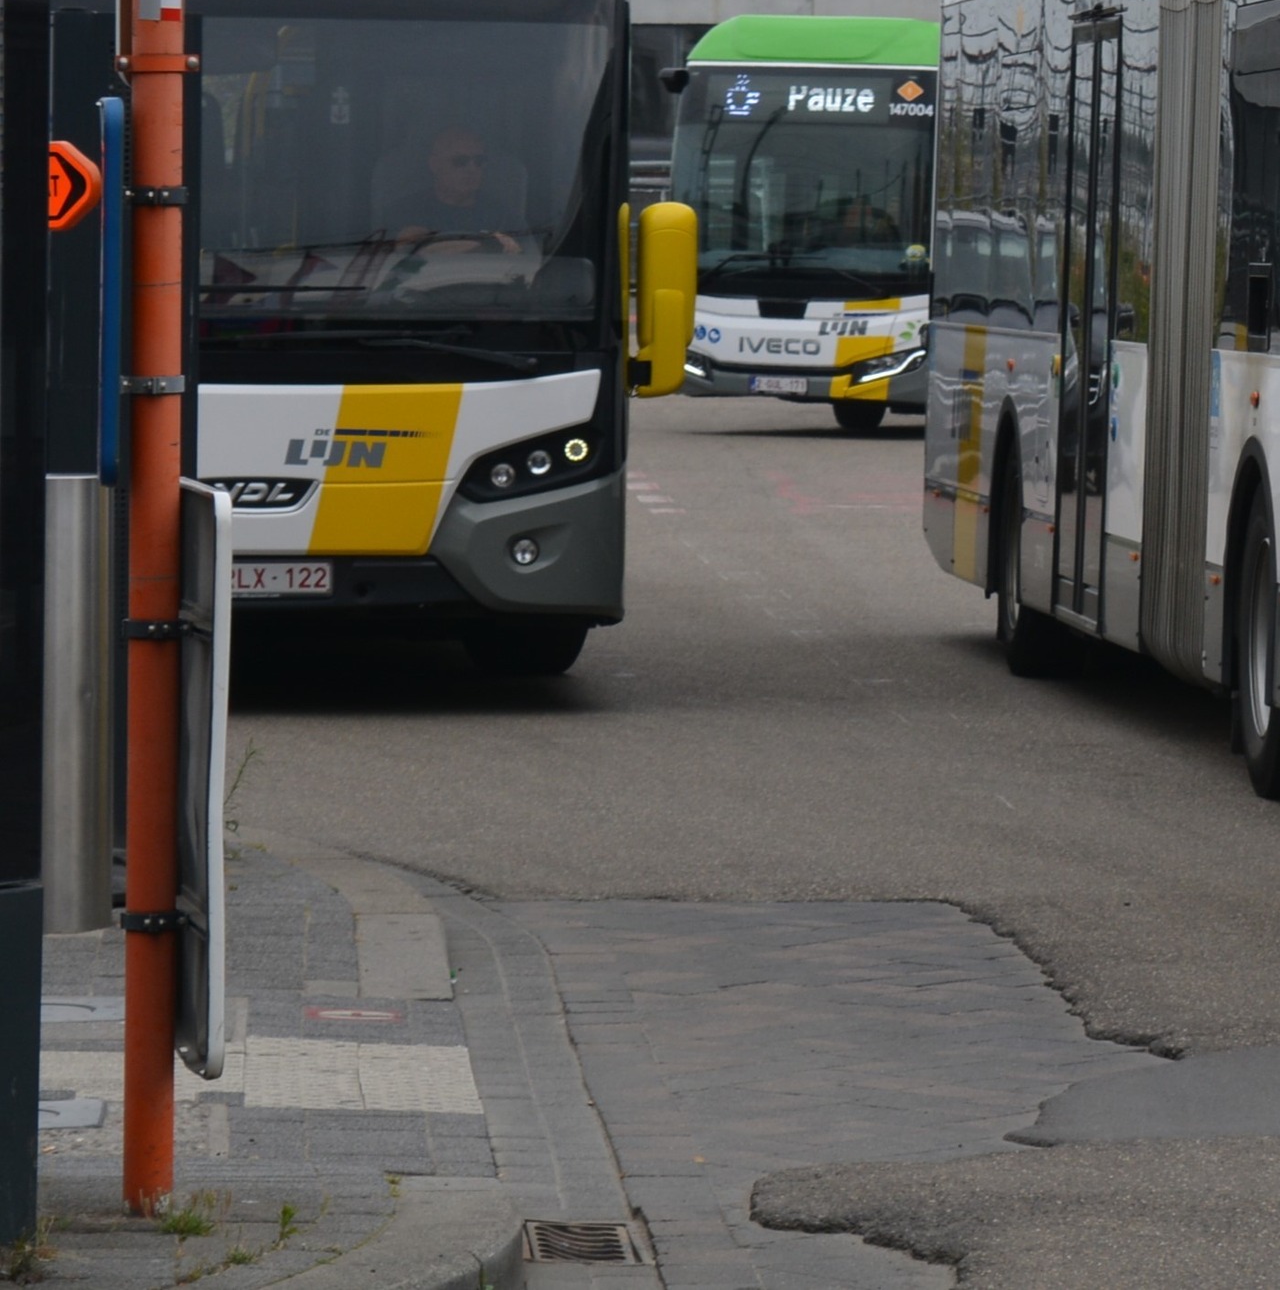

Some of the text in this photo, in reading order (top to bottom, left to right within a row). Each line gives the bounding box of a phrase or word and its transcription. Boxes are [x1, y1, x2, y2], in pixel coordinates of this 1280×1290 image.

[787, 86, 875, 112] Pauze
[889, 103, 934, 117] 147004
[818, 320, 868, 336] LIJN
[738, 336, 820, 355] IVECO
[284, 439, 387, 468] LIJN
